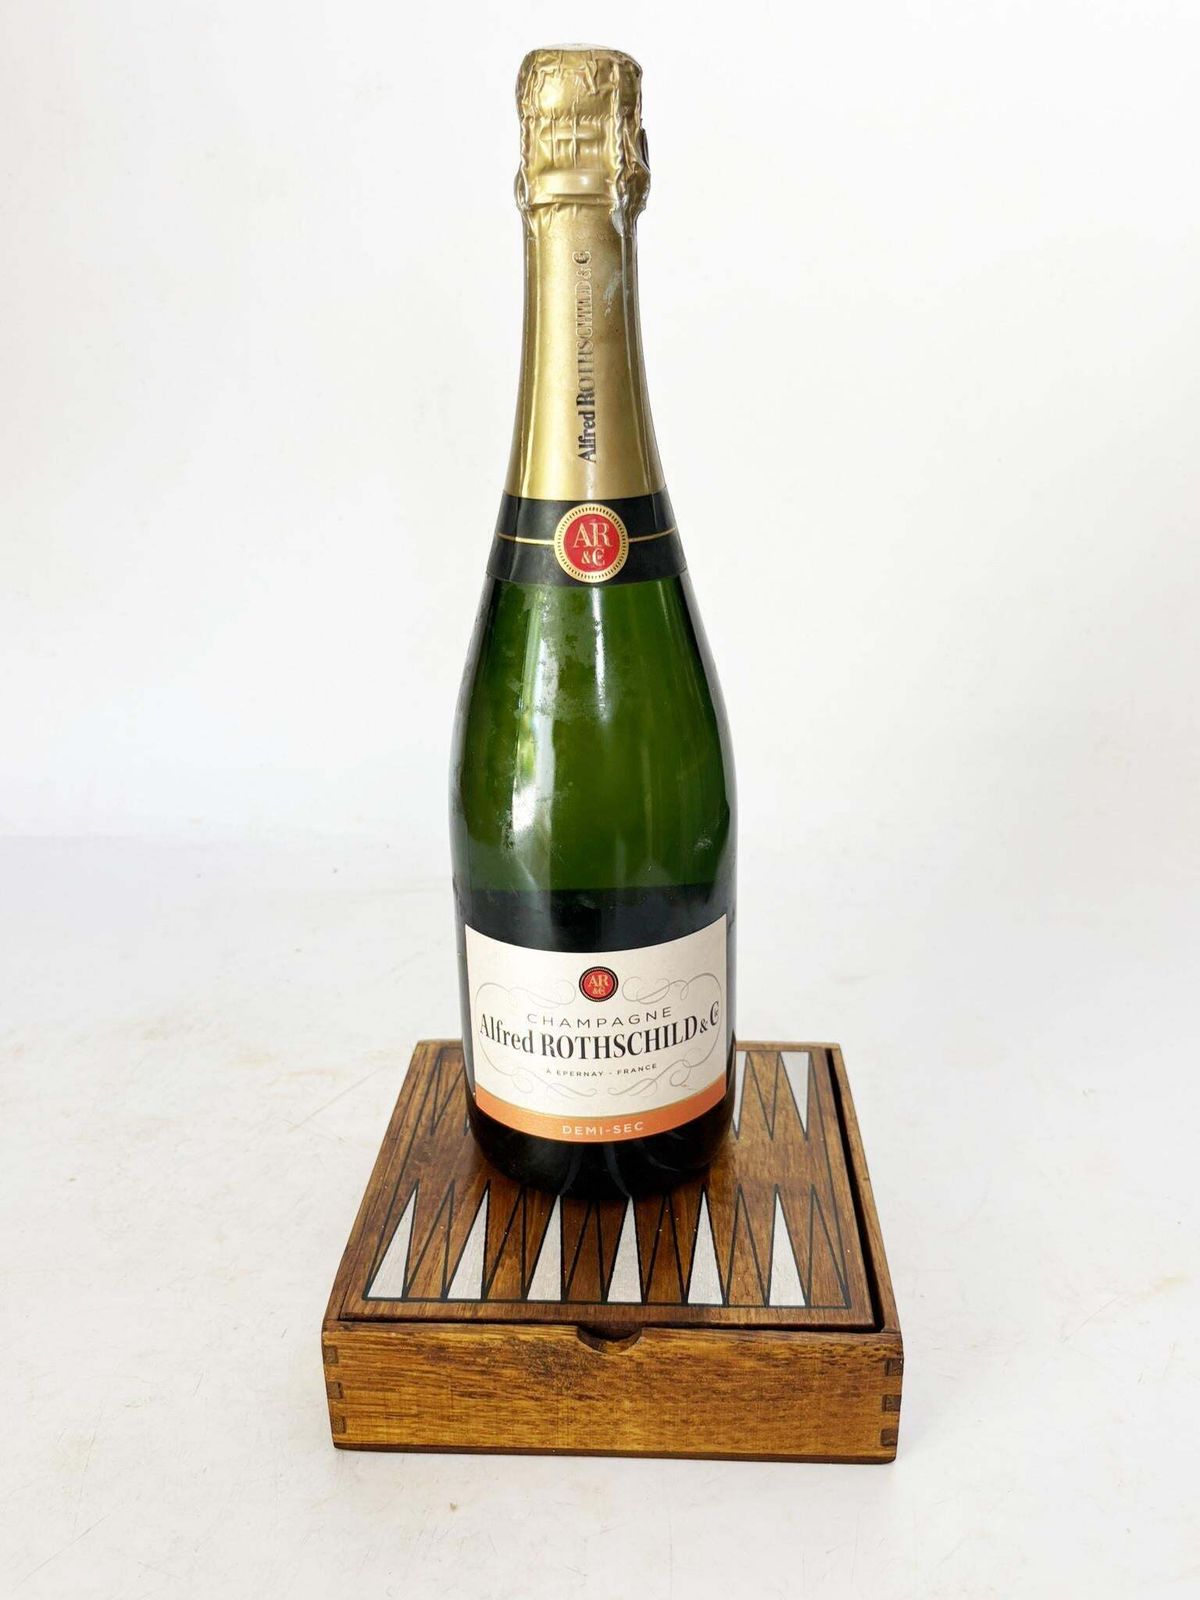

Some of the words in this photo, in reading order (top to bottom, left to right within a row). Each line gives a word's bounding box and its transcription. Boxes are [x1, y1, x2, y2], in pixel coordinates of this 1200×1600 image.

[577, 267, 592, 279] &
[575, 280, 595, 407] ROTHSCHILD
[578, 411, 597, 463] Alfred
[572, 522, 613, 549] AR
[588, 974, 609, 987] AR
[526, 1006, 672, 1029] CHAMPAGNE
[479, 1013, 534, 1055] Alfred
[540, 1015, 698, 1060] ROTHSCHILD
[699, 1018, 708, 1033] &
[556, 1069, 604, 1077] EPERNAY
[617, 1063, 657, 1075] FRANCE
[562, 1121, 644, 1136] DEMI-SEC
